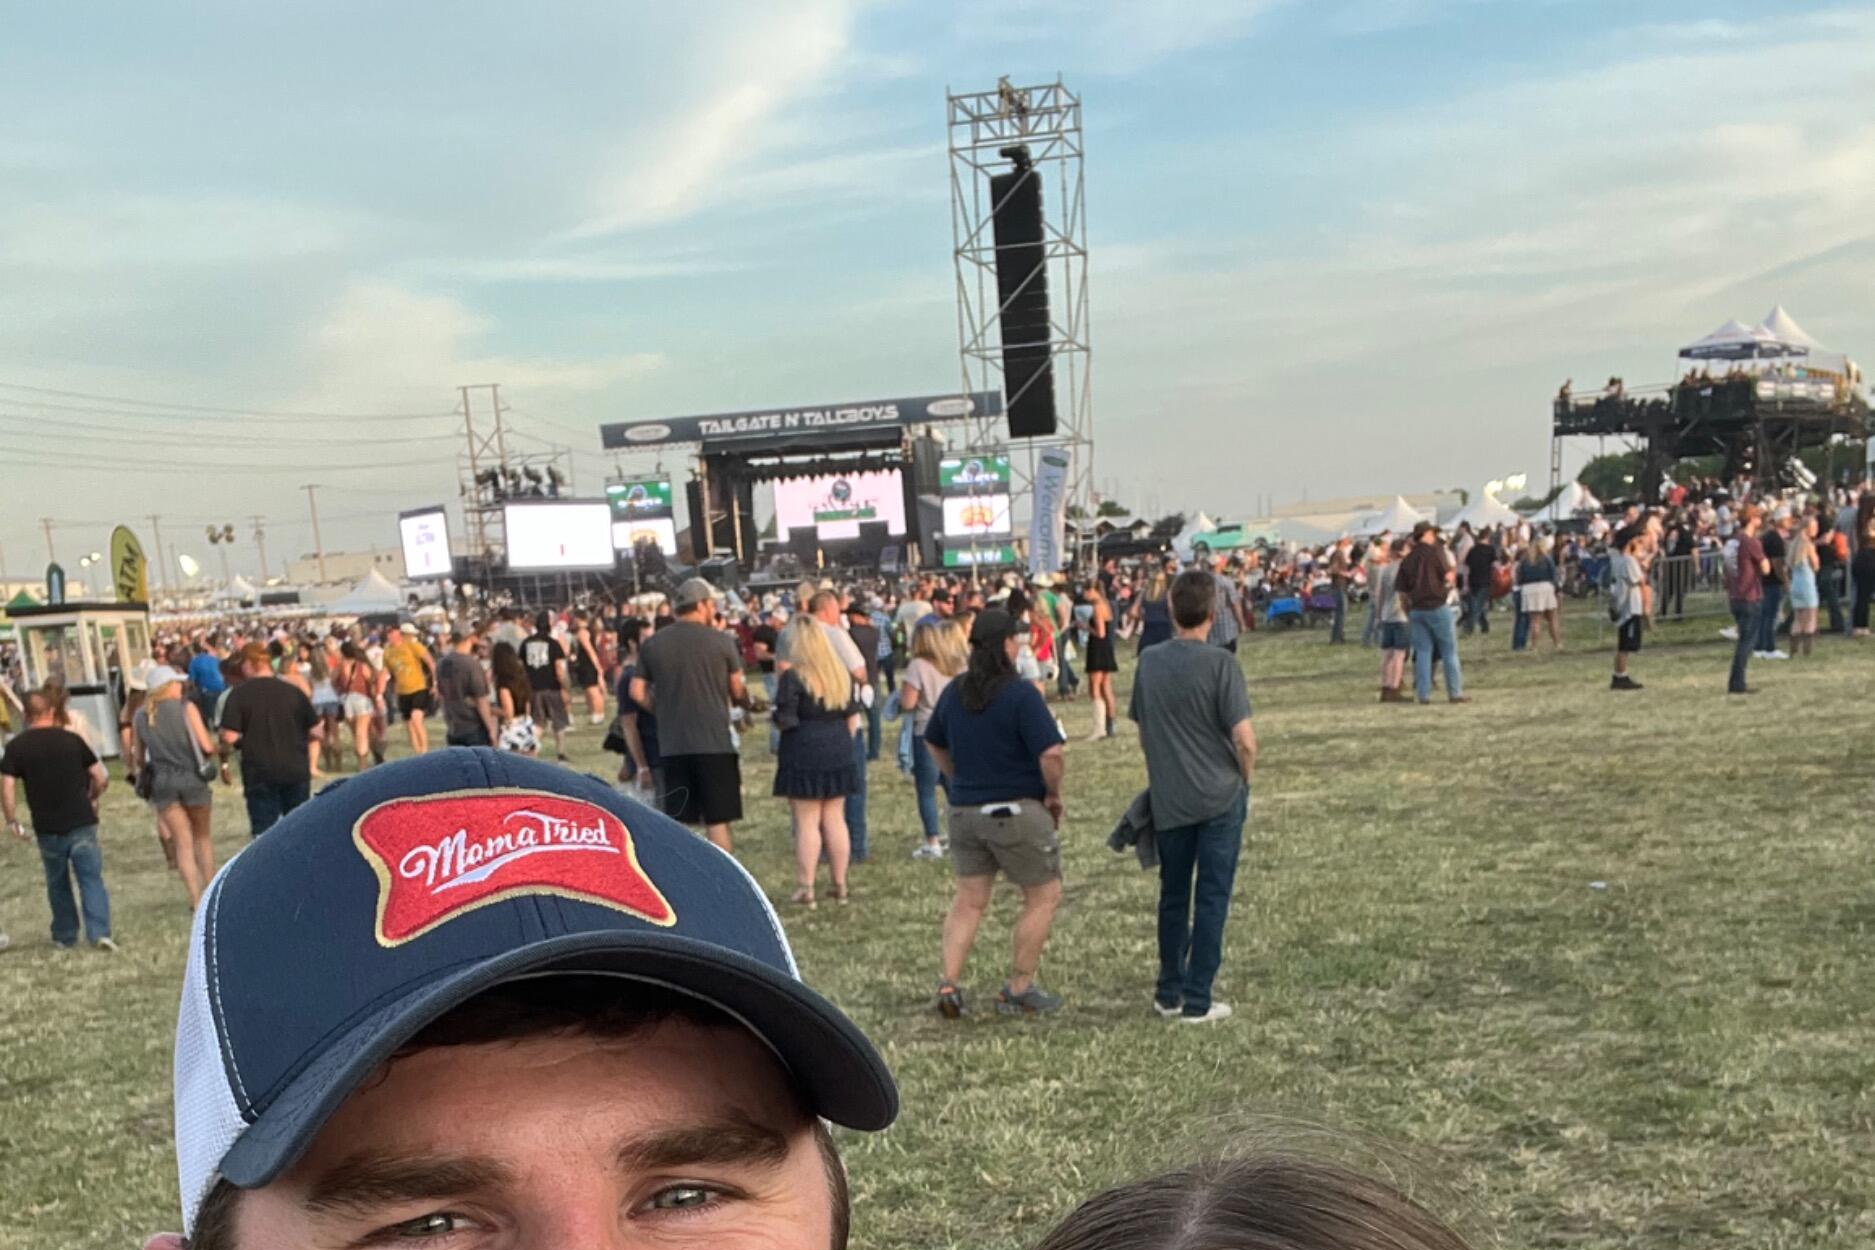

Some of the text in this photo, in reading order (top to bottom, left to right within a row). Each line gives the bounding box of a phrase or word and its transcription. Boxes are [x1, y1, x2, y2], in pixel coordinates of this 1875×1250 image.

[698, 414, 781, 435] TAILGATE
[803, 405, 900, 426] TALLBOYS
[118, 541, 138, 603] ATM
[400, 811, 610, 886] Mama Tried
